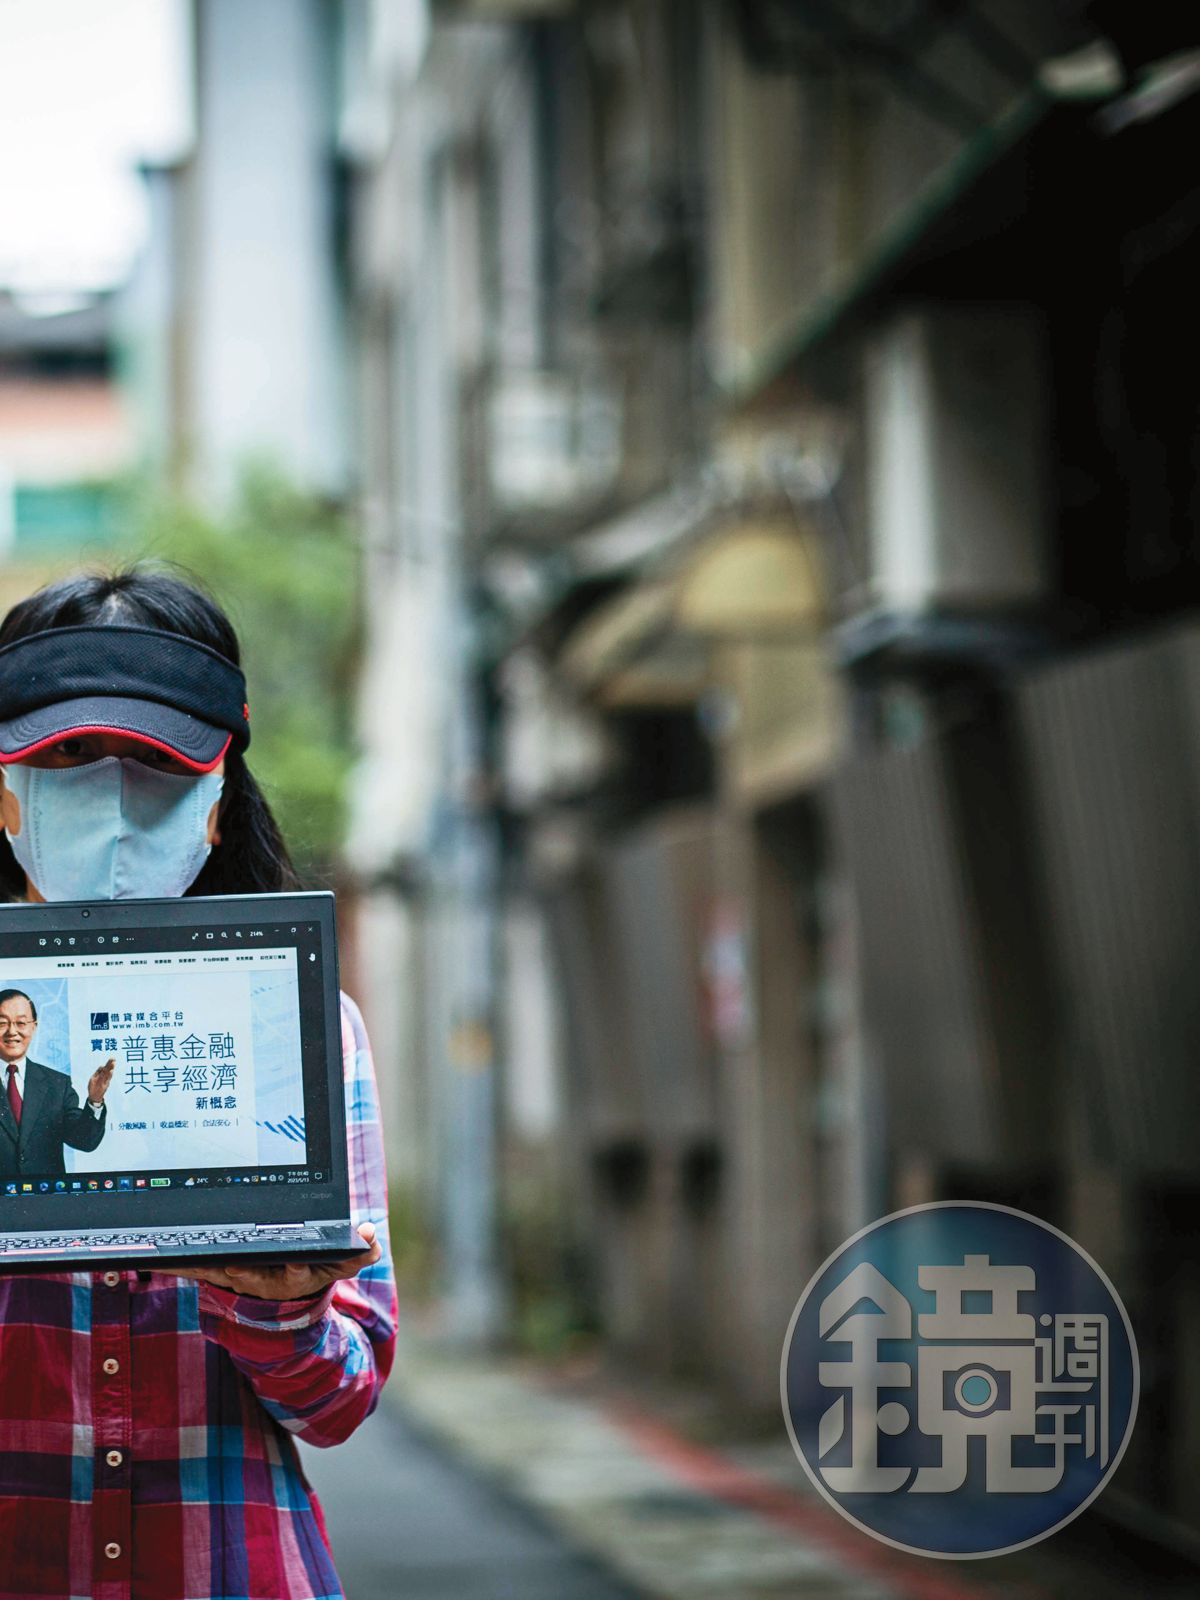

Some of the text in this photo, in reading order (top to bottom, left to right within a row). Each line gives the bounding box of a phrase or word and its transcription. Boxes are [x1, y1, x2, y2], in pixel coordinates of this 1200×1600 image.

[111, 1011, 184, 1022] 借貸媒合平台
[112, 1021, 184, 1029] www.imb.com.tw
[91, 1032, 236, 1062] 實踐 普惠金融
[124, 1063, 238, 1094] 共享經濟
[196, 1096, 237, 1110] 新概念
